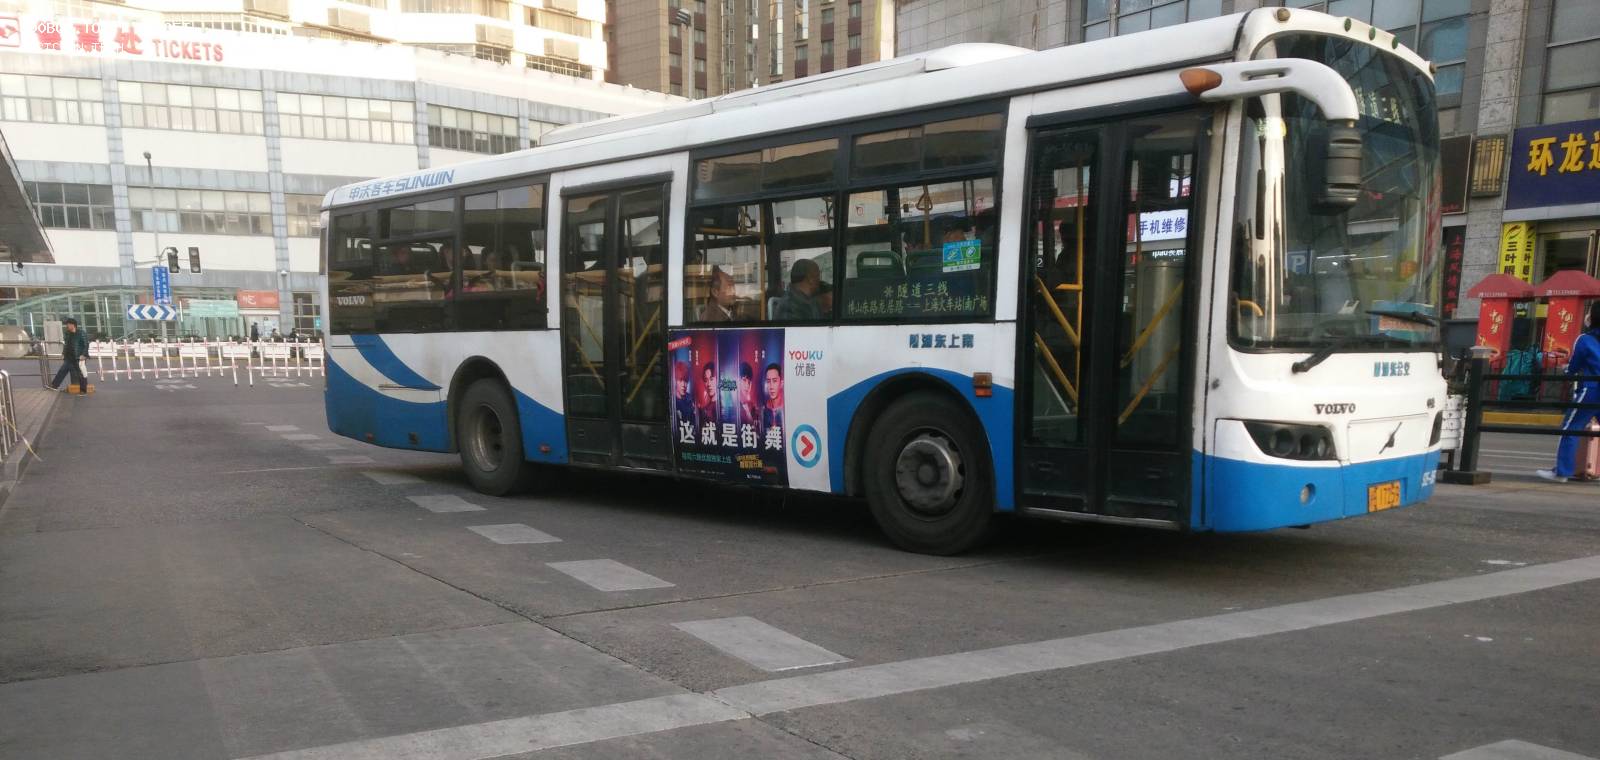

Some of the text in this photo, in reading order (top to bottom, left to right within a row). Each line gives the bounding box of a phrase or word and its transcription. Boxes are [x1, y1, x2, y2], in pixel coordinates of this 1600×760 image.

[152, 38, 224, 63] TICKETS
[394, 169, 454, 192] SUNWIN
[1139, 216, 1186, 236] 手机维修
[897, 281, 949, 298] 隧道三线
[337, 296, 366, 306] VOLVO
[789, 350, 823, 360] YOUKU
[795, 363, 816, 377] 优酷
[1314, 403, 1356, 415] VOLVO
[679, 420, 783, 450] 这就是街舞
